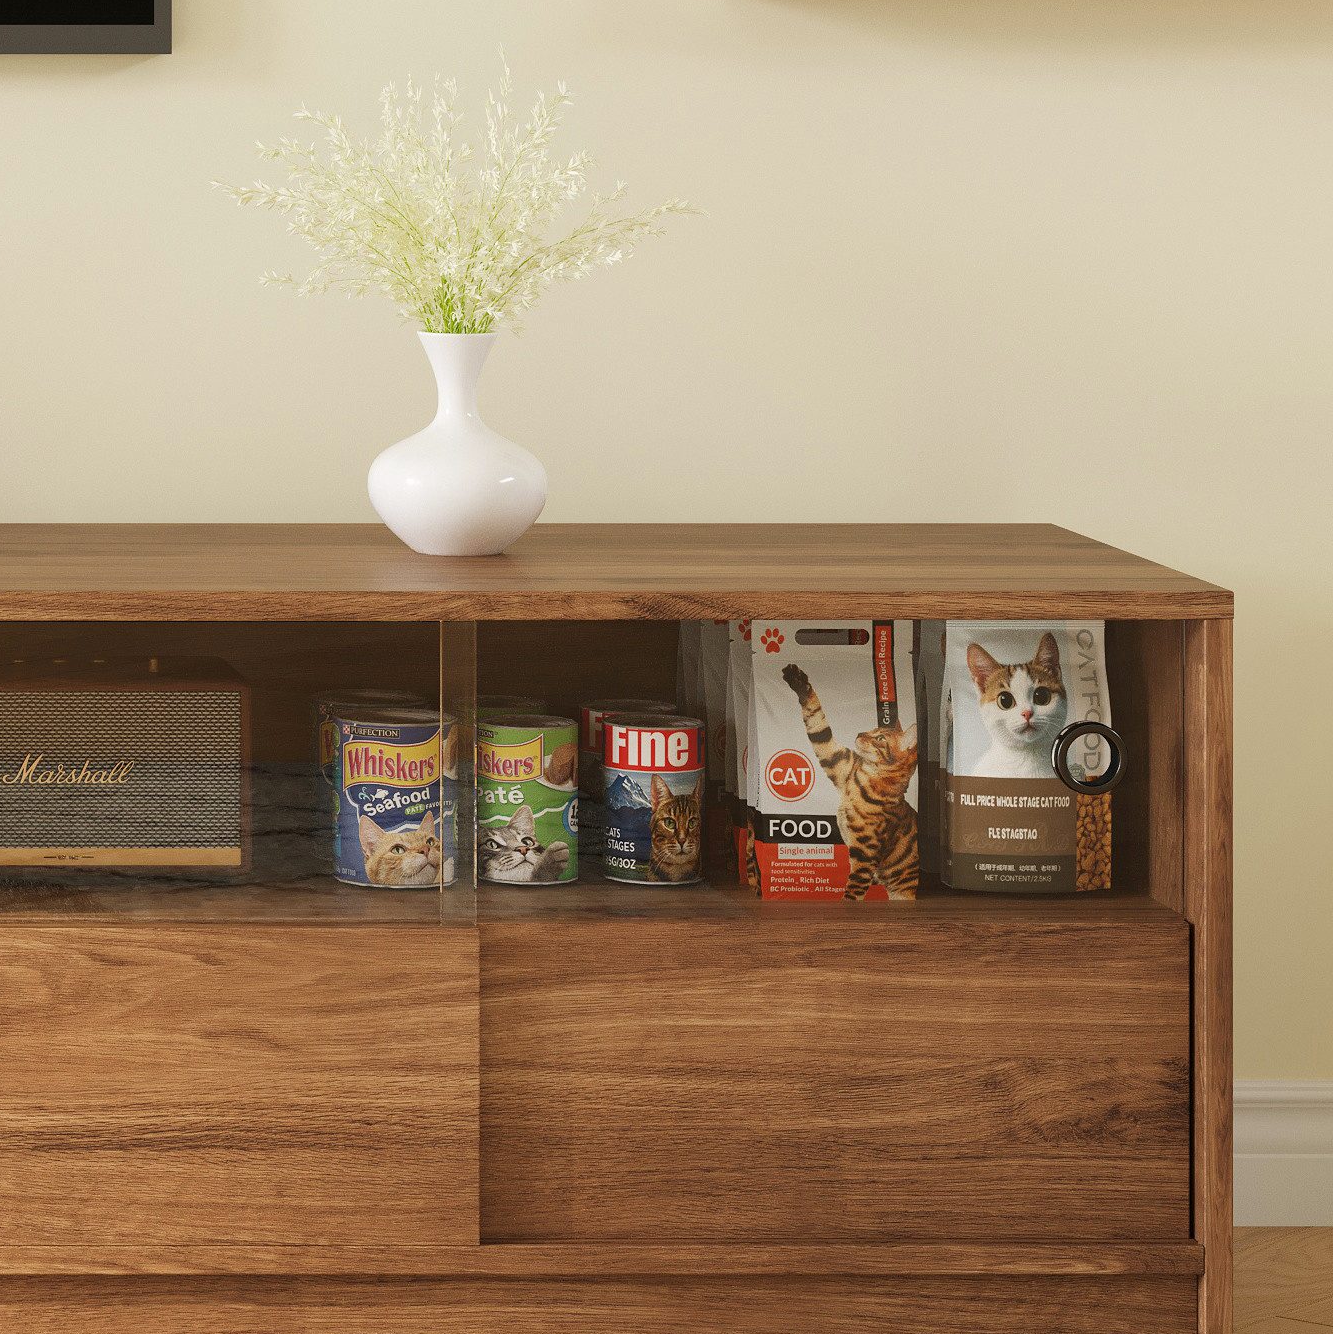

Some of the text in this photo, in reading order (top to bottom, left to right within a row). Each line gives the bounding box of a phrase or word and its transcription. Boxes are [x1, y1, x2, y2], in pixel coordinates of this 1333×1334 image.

[879, 630, 888, 658] Recipe
[879, 660, 888, 680] Duck
[881, 681, 889, 700] Free
[2, 752, 134, 784] Marshall
[347, 746, 434, 781] Whiskers
[478, 746, 535, 777] iskers
[769, 767, 810, 786] CAT
[363, 787, 431, 817] Seafood
[960, 794, 976, 806] FULL
[976, 795, 996, 807] PRICE
[996, 795, 1018, 808] WHOLE
[1018, 796, 1040, 808] STAGE
[1040, 796, 1054, 808] CAT
[1054, 797, 1070, 808] FOOD
[769, 819, 832, 839] FOOD
[607, 838, 635, 852] STAGES
[779, 847, 804, 856] Single
[984, 874, 998, 882] NET
